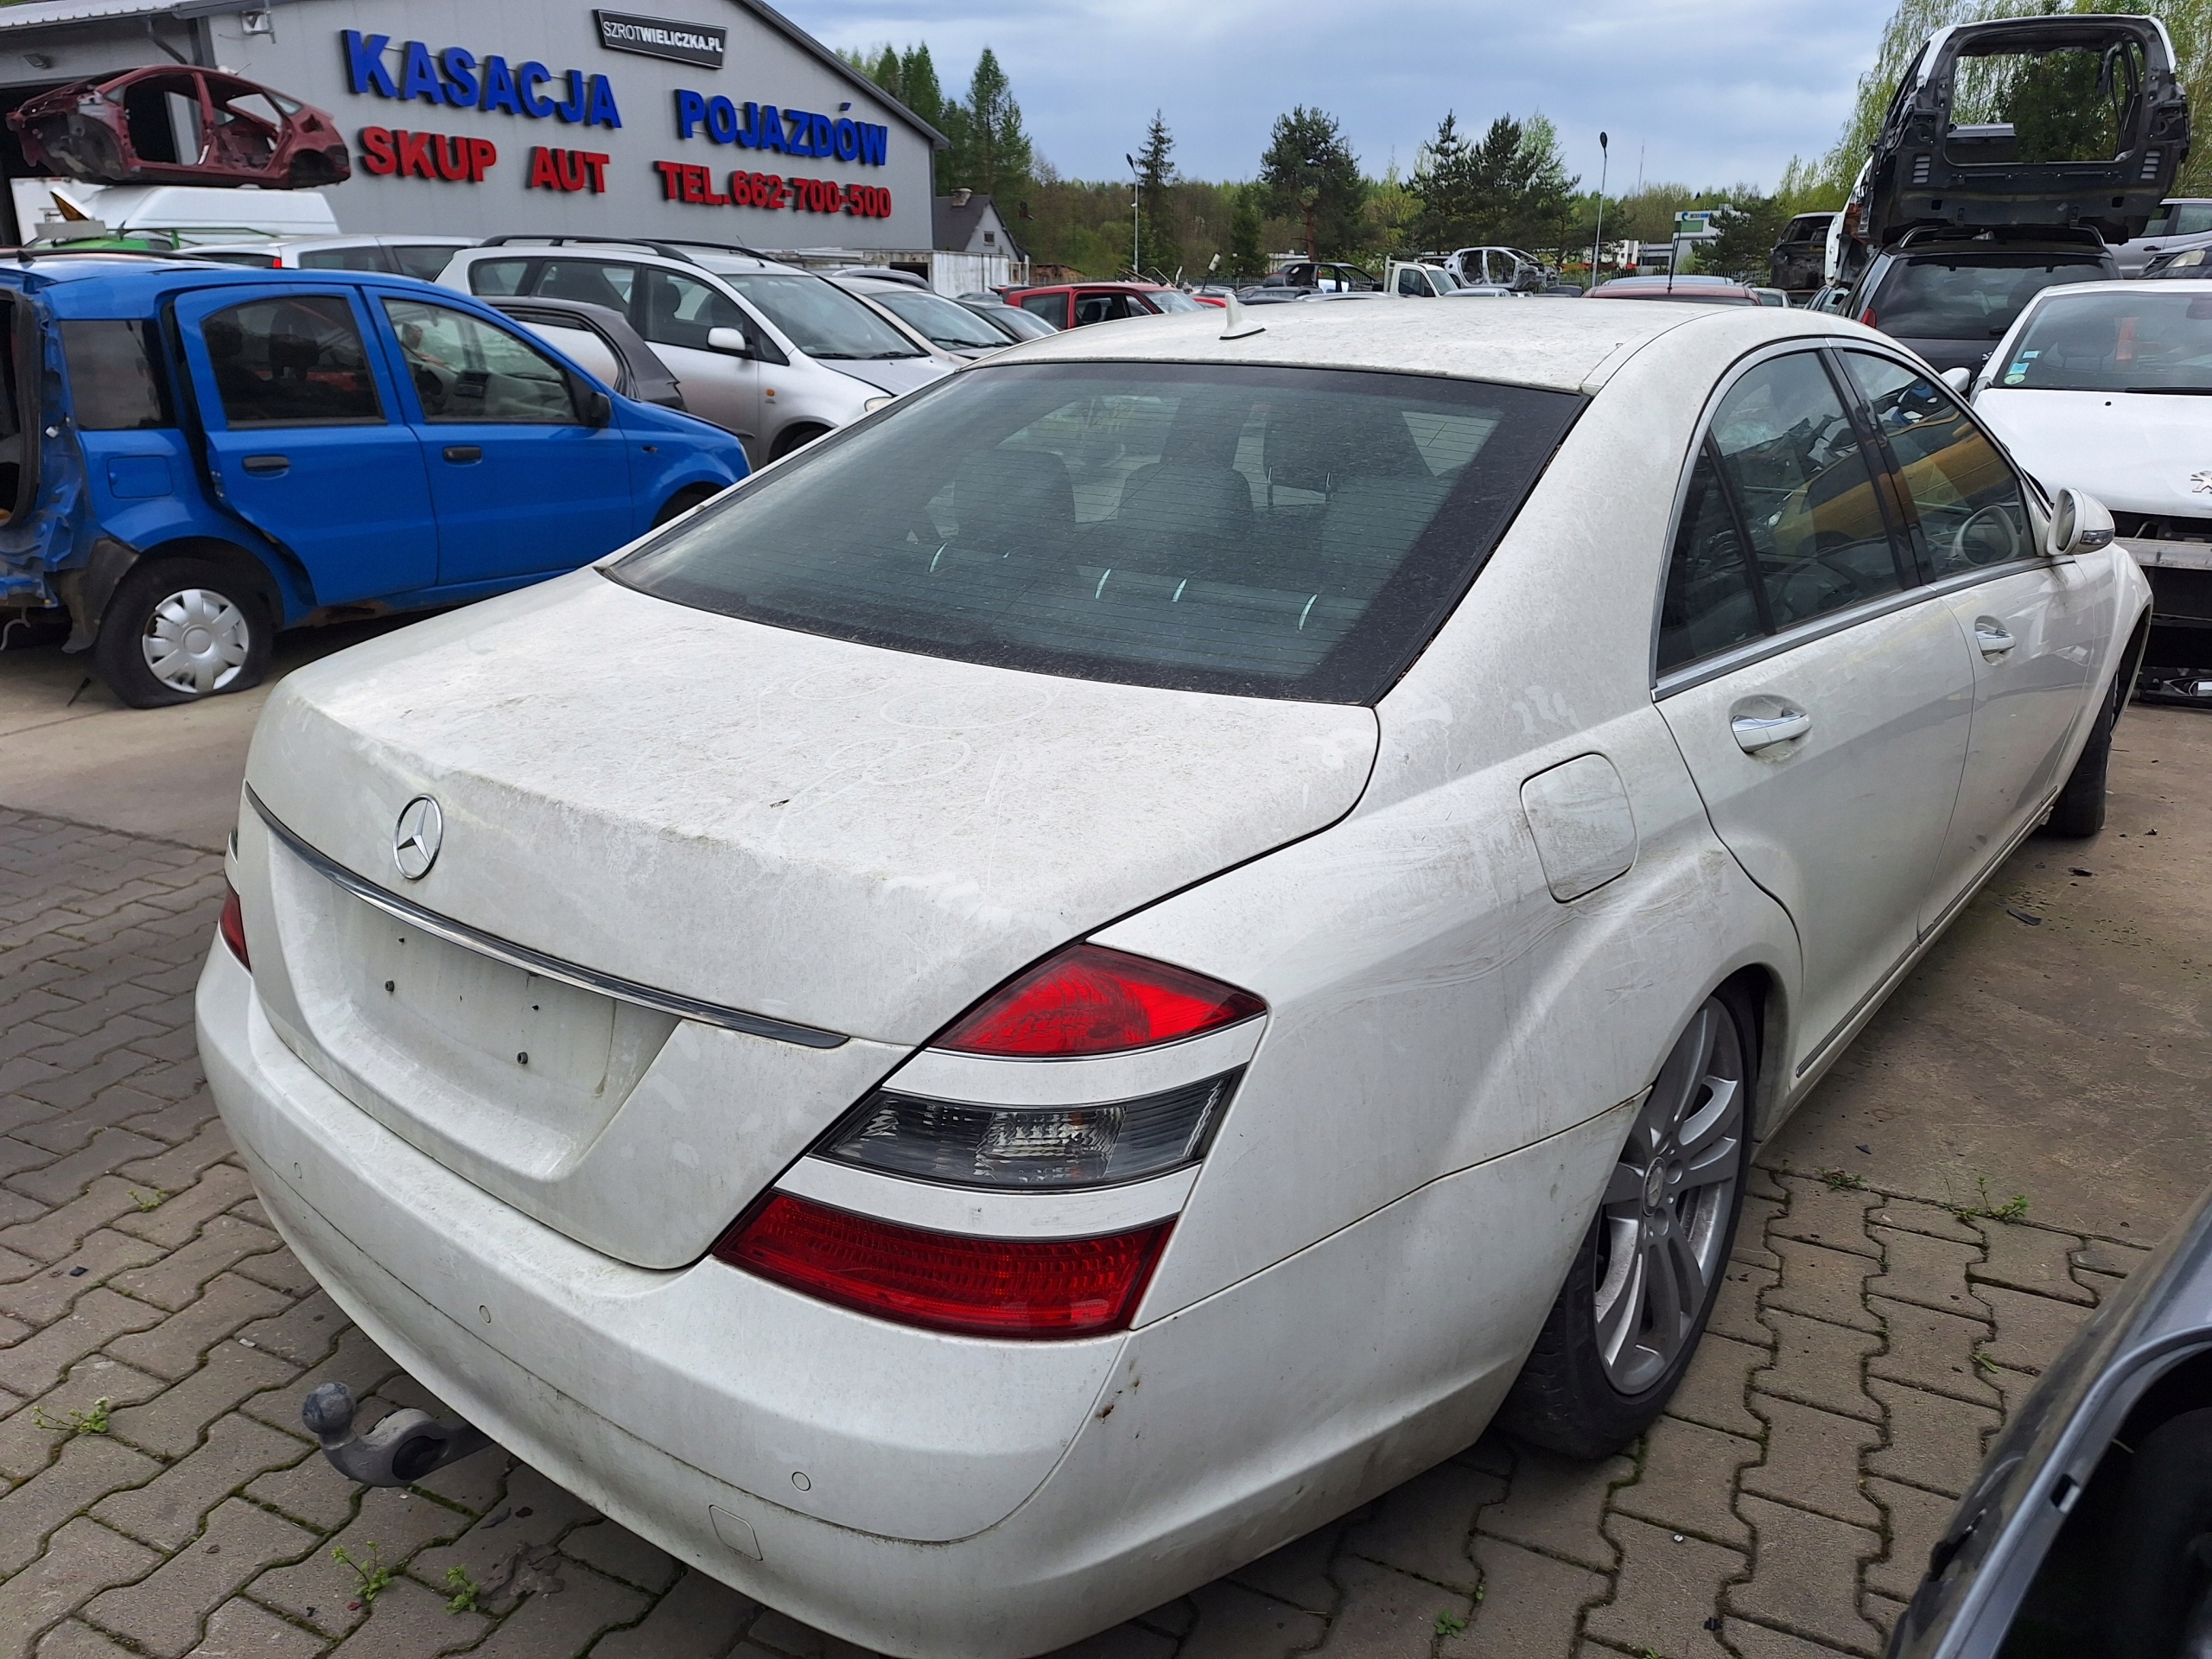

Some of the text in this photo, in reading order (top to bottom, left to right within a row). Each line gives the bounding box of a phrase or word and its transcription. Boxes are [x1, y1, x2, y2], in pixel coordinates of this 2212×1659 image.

[604, 21, 723, 52] SZROTWIELICZKA.PL
[341, 29, 887, 166] KASACJA POJAZDÓW
[359, 126, 892, 218] SKUP AUT TEL.662-700-500
